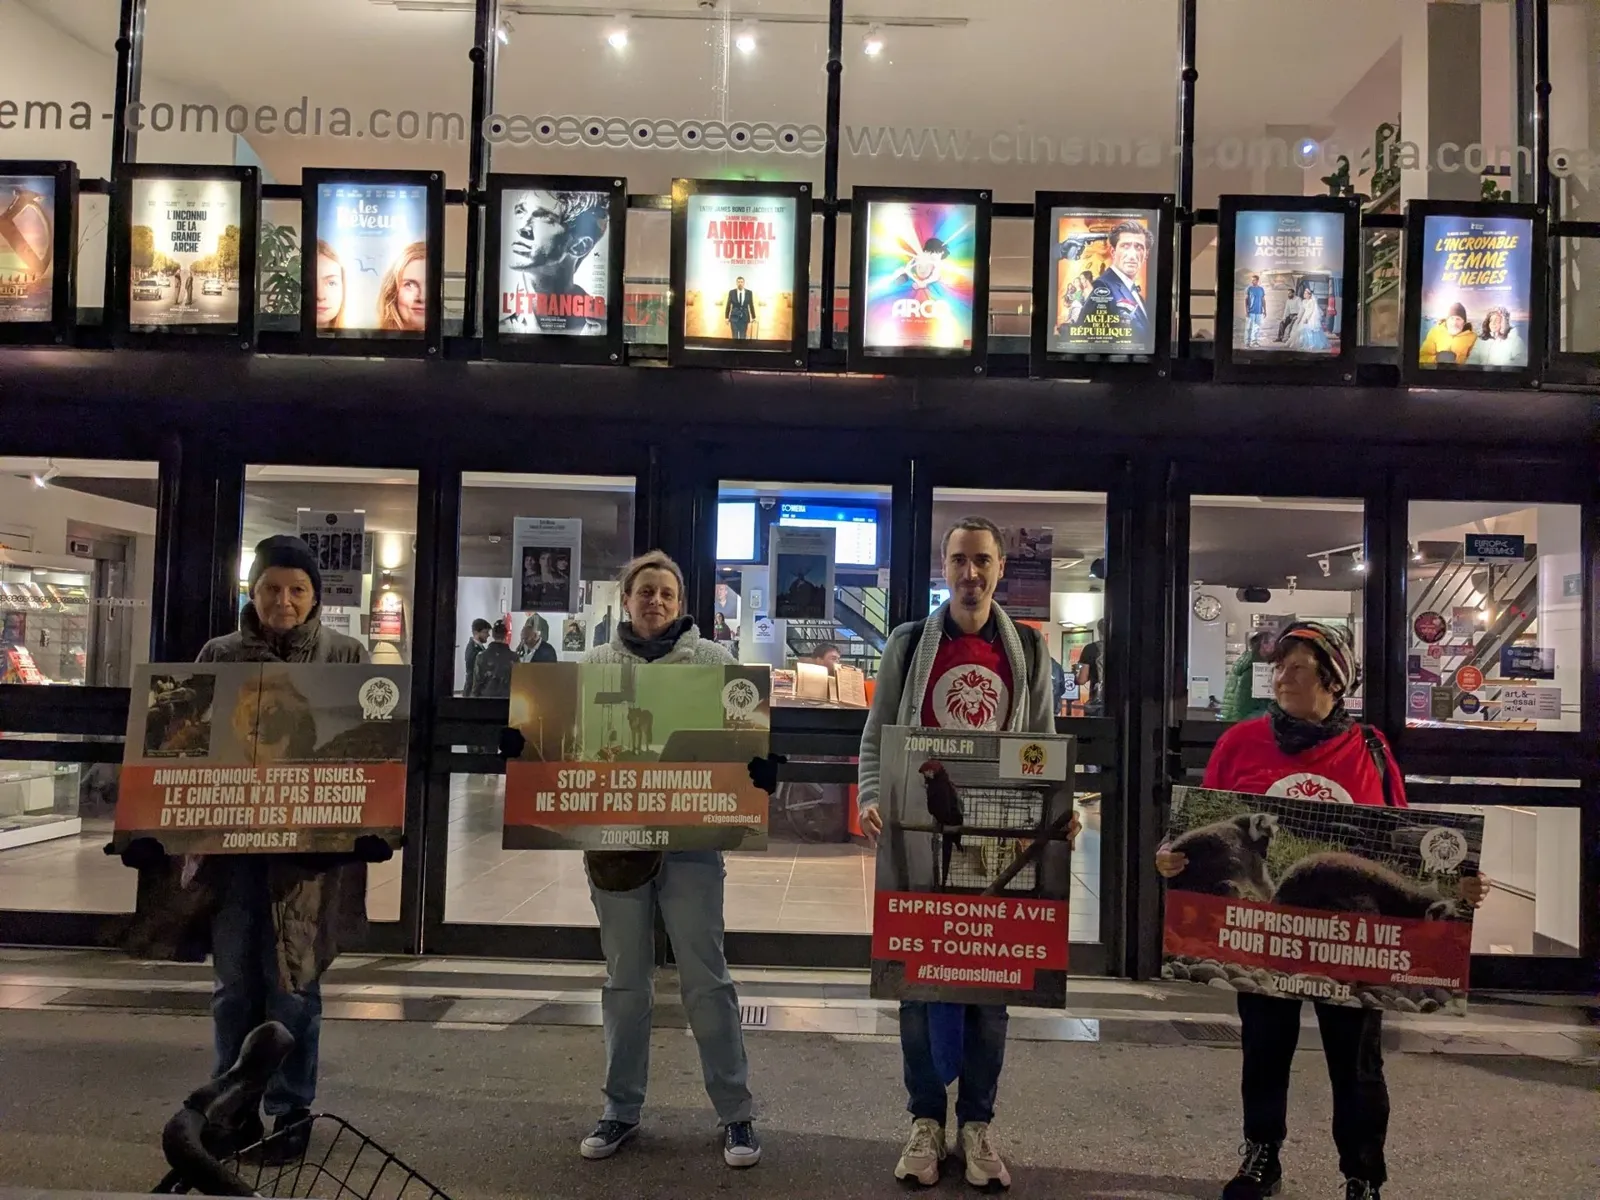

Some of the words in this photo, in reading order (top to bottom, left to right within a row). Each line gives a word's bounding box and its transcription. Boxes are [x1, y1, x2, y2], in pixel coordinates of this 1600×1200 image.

[167, 210, 207, 221] L'INCONNU
[176, 221, 186, 231] DE
[187, 221, 197, 231] LA
[707, 221, 776, 240] ANIMAL
[171, 231, 201, 242] GRANDE
[1254, 235, 1274, 246] UN
[1275, 235, 1324, 246] SIMPLE
[1435, 235, 1519, 251] L'INCROYABLE
[173, 242, 199, 252] ARCHE
[713, 240, 770, 259] TOTEM
[1254, 246, 1324, 257] ACCIDENT
[1444, 250, 1509, 270] FEMME
[1458, 270, 1509, 286] NEIGES
[502, 289, 606, 318] L'ÉTRANGER
[1084, 314, 1120, 323] AIGLES
[1069, 325, 1132, 337] RÉPUBLIQUE
[362, 704, 394, 721] PAZ
[904, 737, 974, 755] ZOOPOLIS.FR
[153, 767, 262, 785] ANIMATRONIQUE,
[265, 767, 311, 784] EFFETS
[313, 767, 376, 783] VISUELS...
[1021, 763, 1044, 775] PAZ
[557, 770, 596, 790] STOP
[610, 770, 637, 790] LES
[641, 770, 712, 790] ANIMAUX
[165, 787, 182, 805] LE
[186, 784, 245, 805] CINÉMA
[251, 786, 275, 804] N'A
[280, 786, 310, 804] PAS
[313, 785, 367, 804] BESOIN
[536, 792, 555, 812] NE
[560, 792, 598, 812] SONT
[603, 792, 633, 812] PAS
[637, 792, 666, 812] DES
[670, 792, 738, 812] ACTEURS
[160, 806, 255, 827] D'EXPLOITER
[259, 806, 287, 825] DES
[292, 805, 363, 825] ANIMAUX
[222, 832, 297, 848] ZOOPOLIS.FR
[601, 830, 670, 846] ZOOPOLIS.FR
[888, 898, 1006, 919] EMPRISONNÉ
[1013, 901, 1026, 920] À
[1027, 906, 1056, 922] VIE
[943, 921, 994, 937] POUR
[1225, 905, 1350, 942] EMPRISONNÉS
[1355, 917, 1368, 945] À
[1373, 923, 1402, 947] VIE
[888, 936, 924, 952] DES
[931, 939, 1047, 959] TOURNAGES
[1218, 927, 1264, 954] POUR
[1269, 934, 1303, 961] DES
[1308, 942, 1411, 972] TOURNAGES
[917, 964, 1022, 985] #ExigeonsUneLoi
[1272, 975, 1351, 1000] ZOOPOLIS.FR
